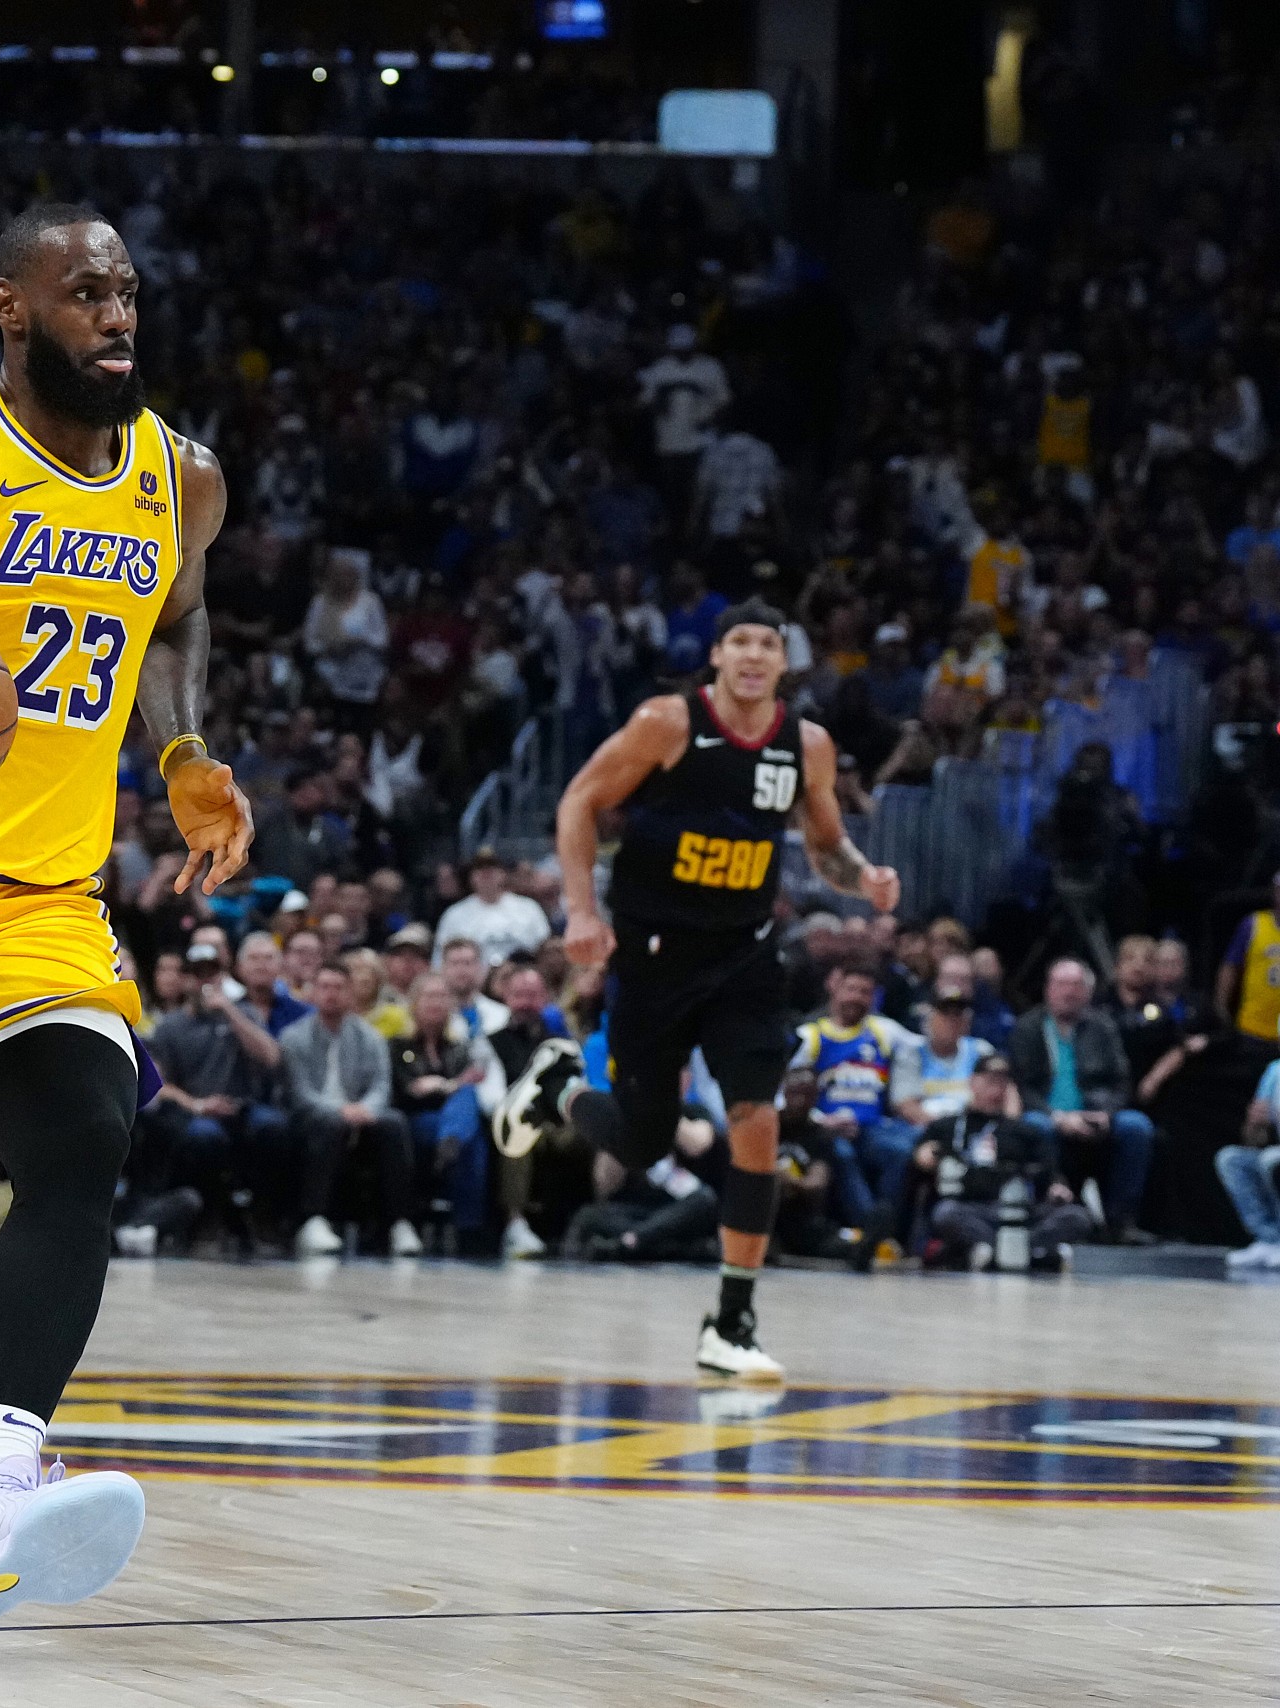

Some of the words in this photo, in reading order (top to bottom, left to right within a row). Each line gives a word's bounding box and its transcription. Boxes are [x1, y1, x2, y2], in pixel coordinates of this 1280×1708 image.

[133, 494, 167, 517] bibigo
[12, 602, 127, 731] 23
[752, 761, 798, 813] 50
[672, 831, 775, 890] 5280
